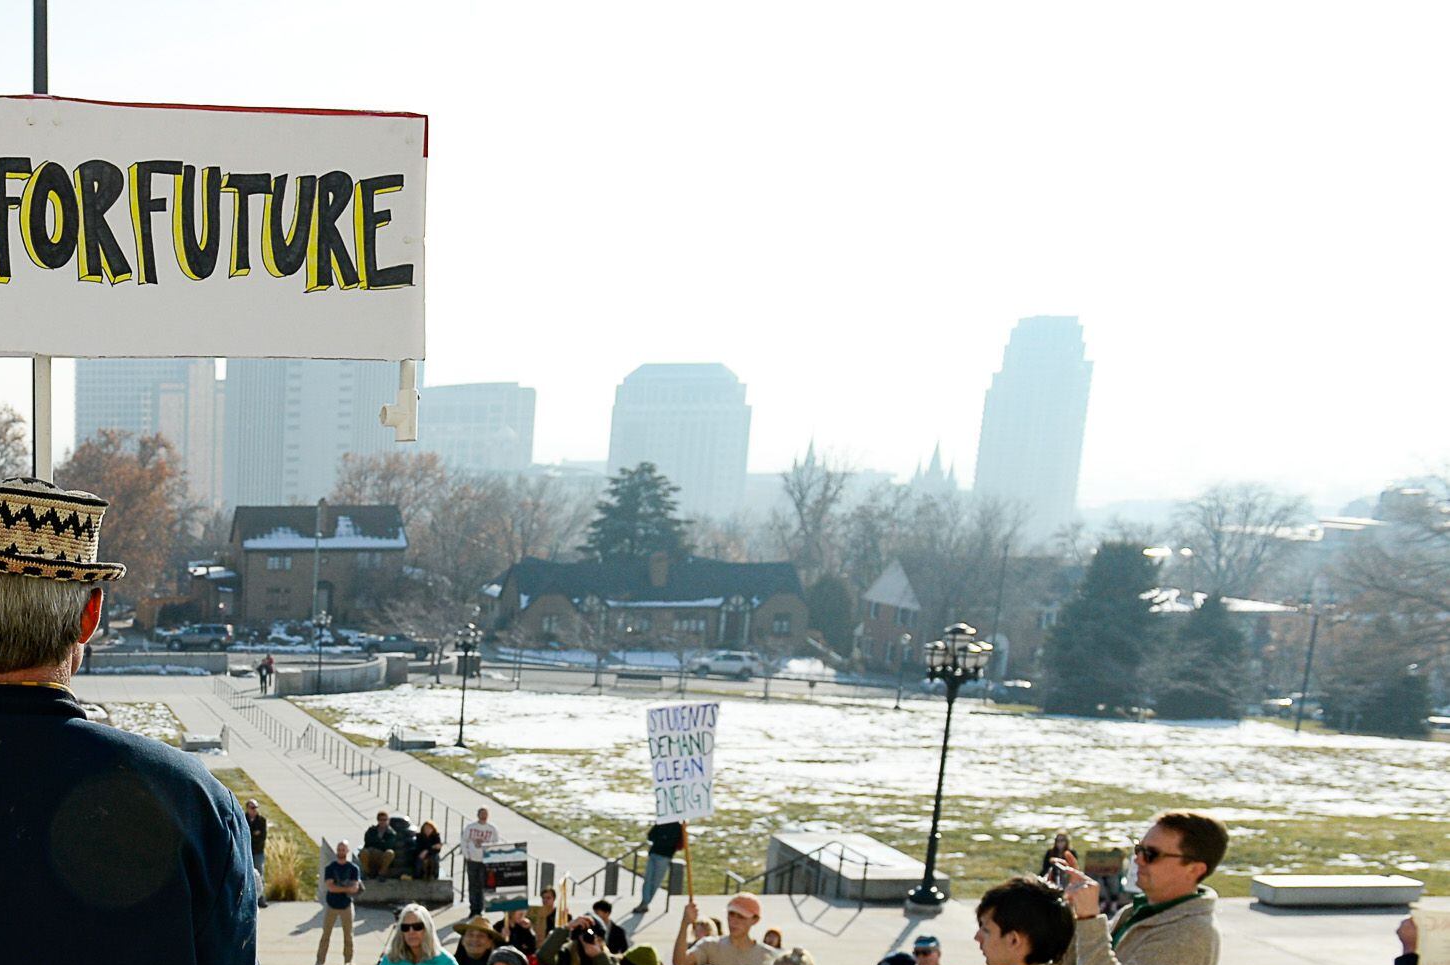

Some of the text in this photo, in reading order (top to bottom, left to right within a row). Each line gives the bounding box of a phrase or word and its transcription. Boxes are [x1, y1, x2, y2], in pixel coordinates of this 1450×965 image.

[648, 703, 719, 732] STUDENTS
[648, 731, 714, 759] DEMAND
[655, 757, 704, 782] CLEAN
[655, 782, 712, 816] ENERGY
